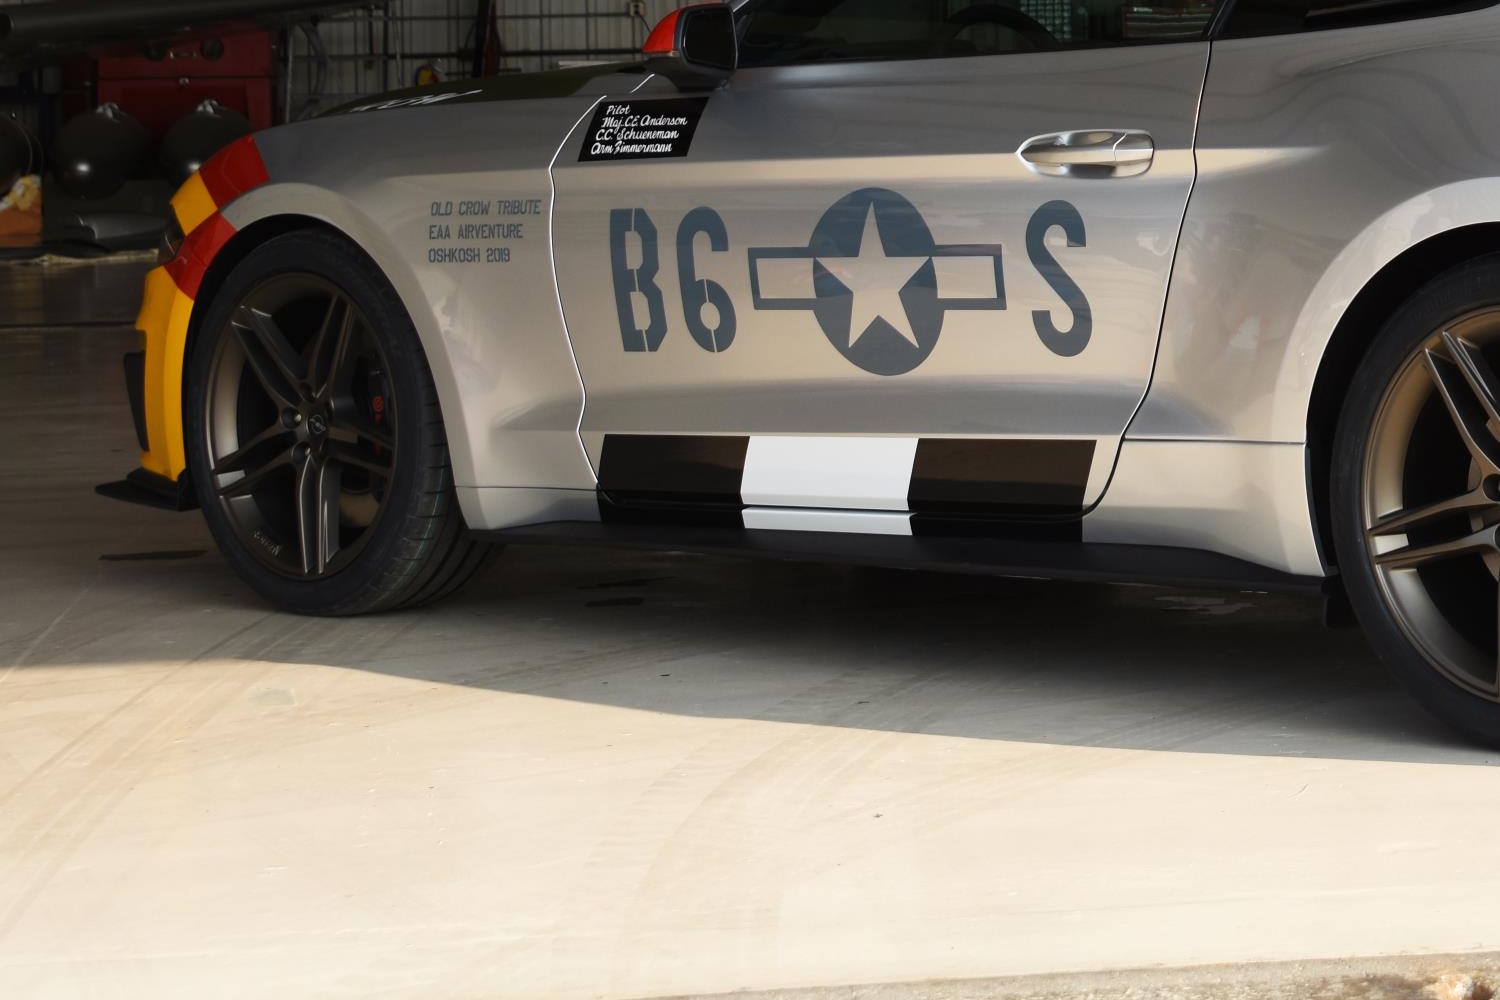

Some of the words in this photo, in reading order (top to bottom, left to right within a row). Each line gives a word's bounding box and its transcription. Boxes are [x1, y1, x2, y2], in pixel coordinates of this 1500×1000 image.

[606, 104, 631, 115] Pilot
[640, 114, 688, 126] Anderson
[431, 201, 453, 216] OLD
[458, 200, 490, 216] CROW
[497, 199, 542, 215] TRIBUTE
[429, 225, 451, 240] EAA
[457, 223, 524, 239] AIRVENTURE
[428, 247, 481, 263] OSHKOSH
[486, 247, 511, 263] 2019
[609, 206, 737, 353] B6
[1025, 199, 1093, 357] S
